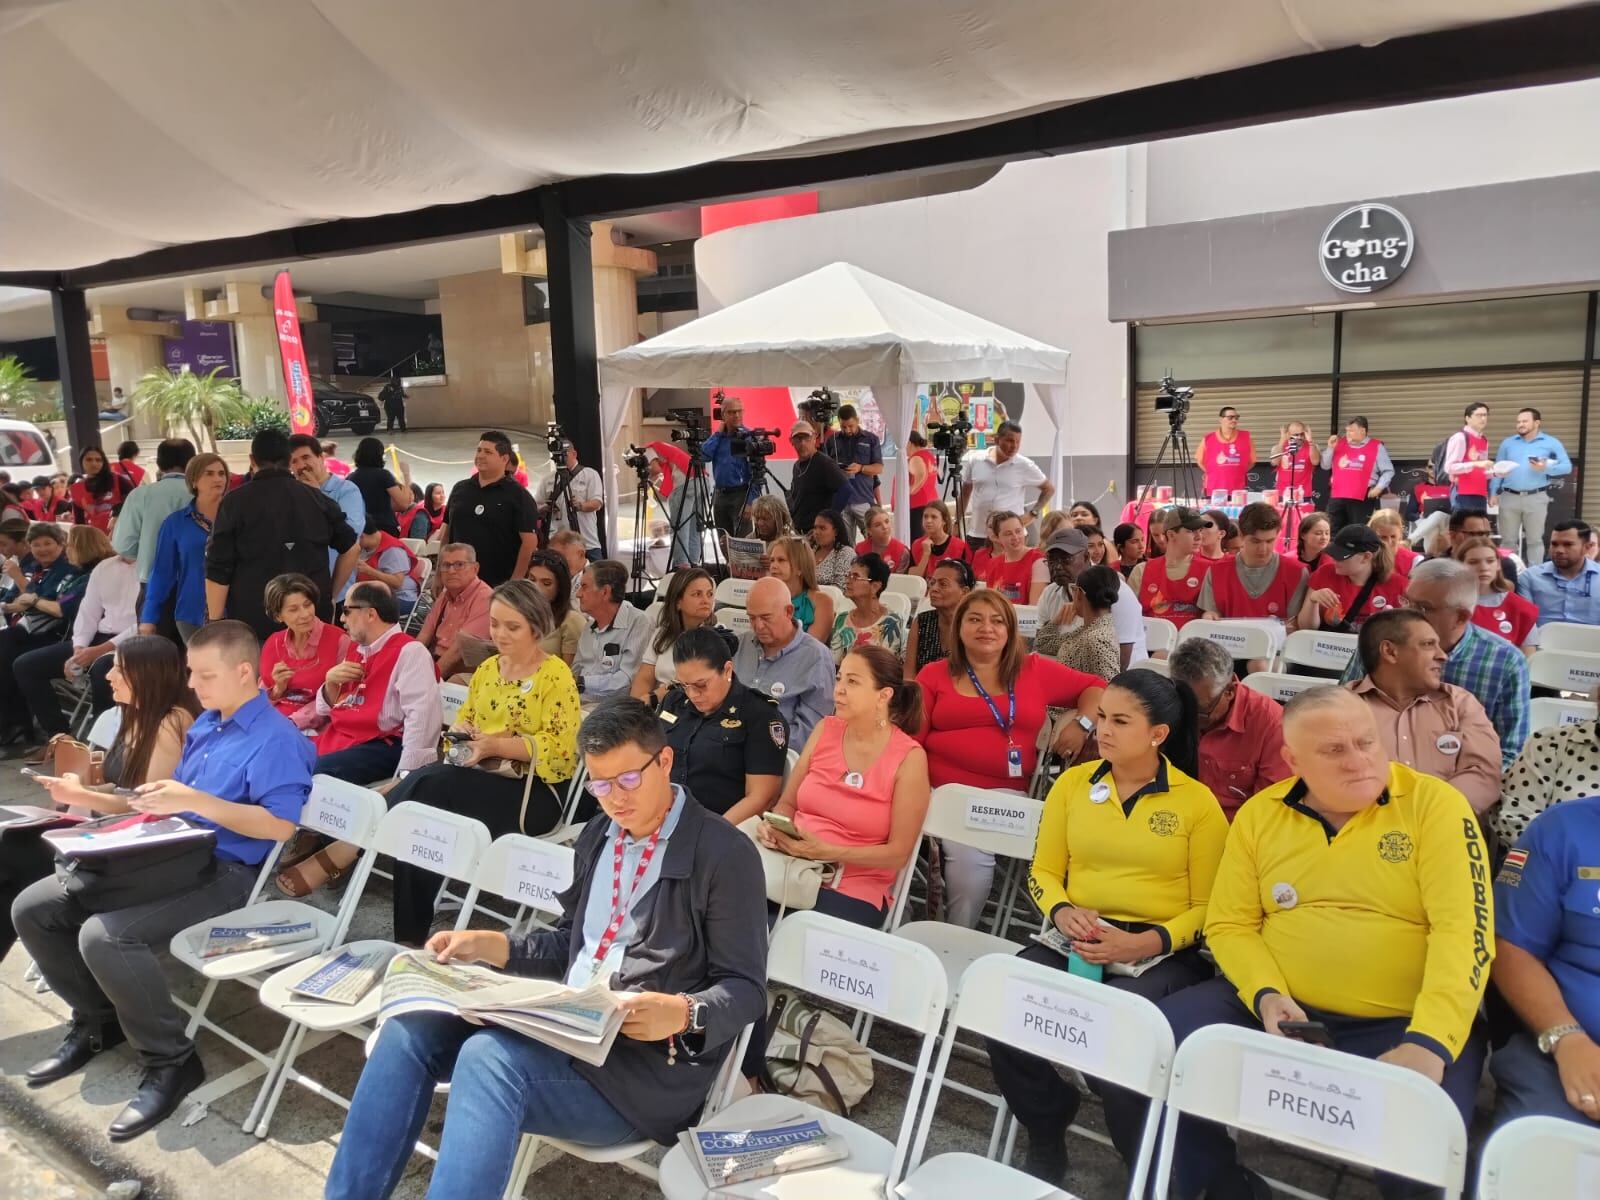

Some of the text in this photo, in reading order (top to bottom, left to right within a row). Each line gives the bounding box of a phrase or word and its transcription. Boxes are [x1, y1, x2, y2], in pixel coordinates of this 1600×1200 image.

[1341, 262, 1388, 283] cha
[1210, 633, 1245, 642] RESERVADO
[319, 811, 347, 831] PRENSA
[971, 804, 1025, 819] RESERVADO
[410, 844, 444, 864] PRENSA
[518, 881, 556, 903] PRENSA
[1462, 818, 1490, 991] BOMBEROS
[820, 969, 875, 1000] PRENSA
[1023, 1011, 1089, 1049] PRENSA
[1267, 1089, 1356, 1131] PRENSA
